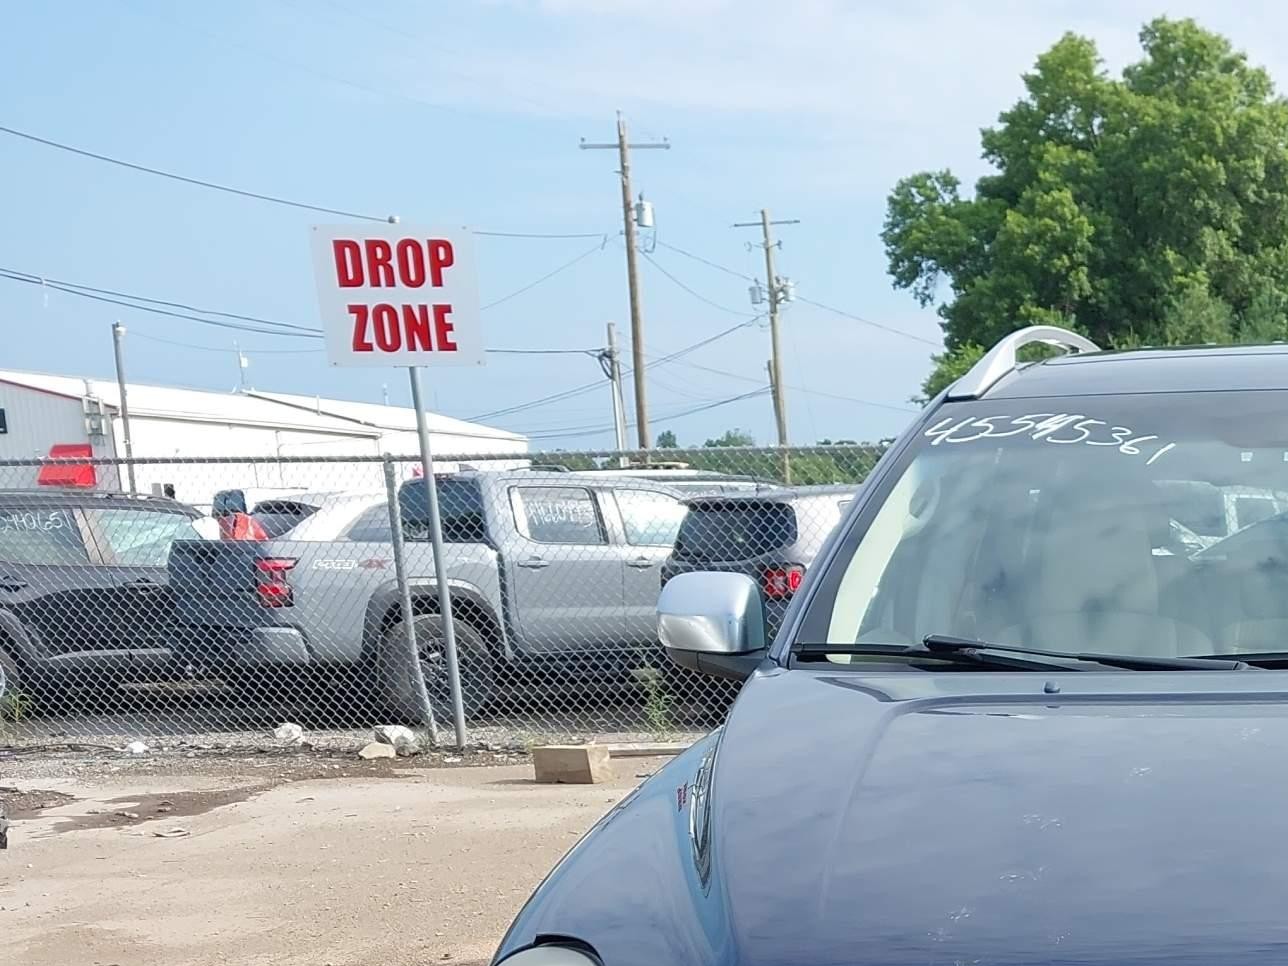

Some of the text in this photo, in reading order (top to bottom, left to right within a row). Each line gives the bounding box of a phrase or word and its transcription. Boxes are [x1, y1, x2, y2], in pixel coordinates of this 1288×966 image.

[332, 238, 454, 288] DROP
[347, 303, 458, 353] ZONE
[924, 413, 1177, 465] 45545361
